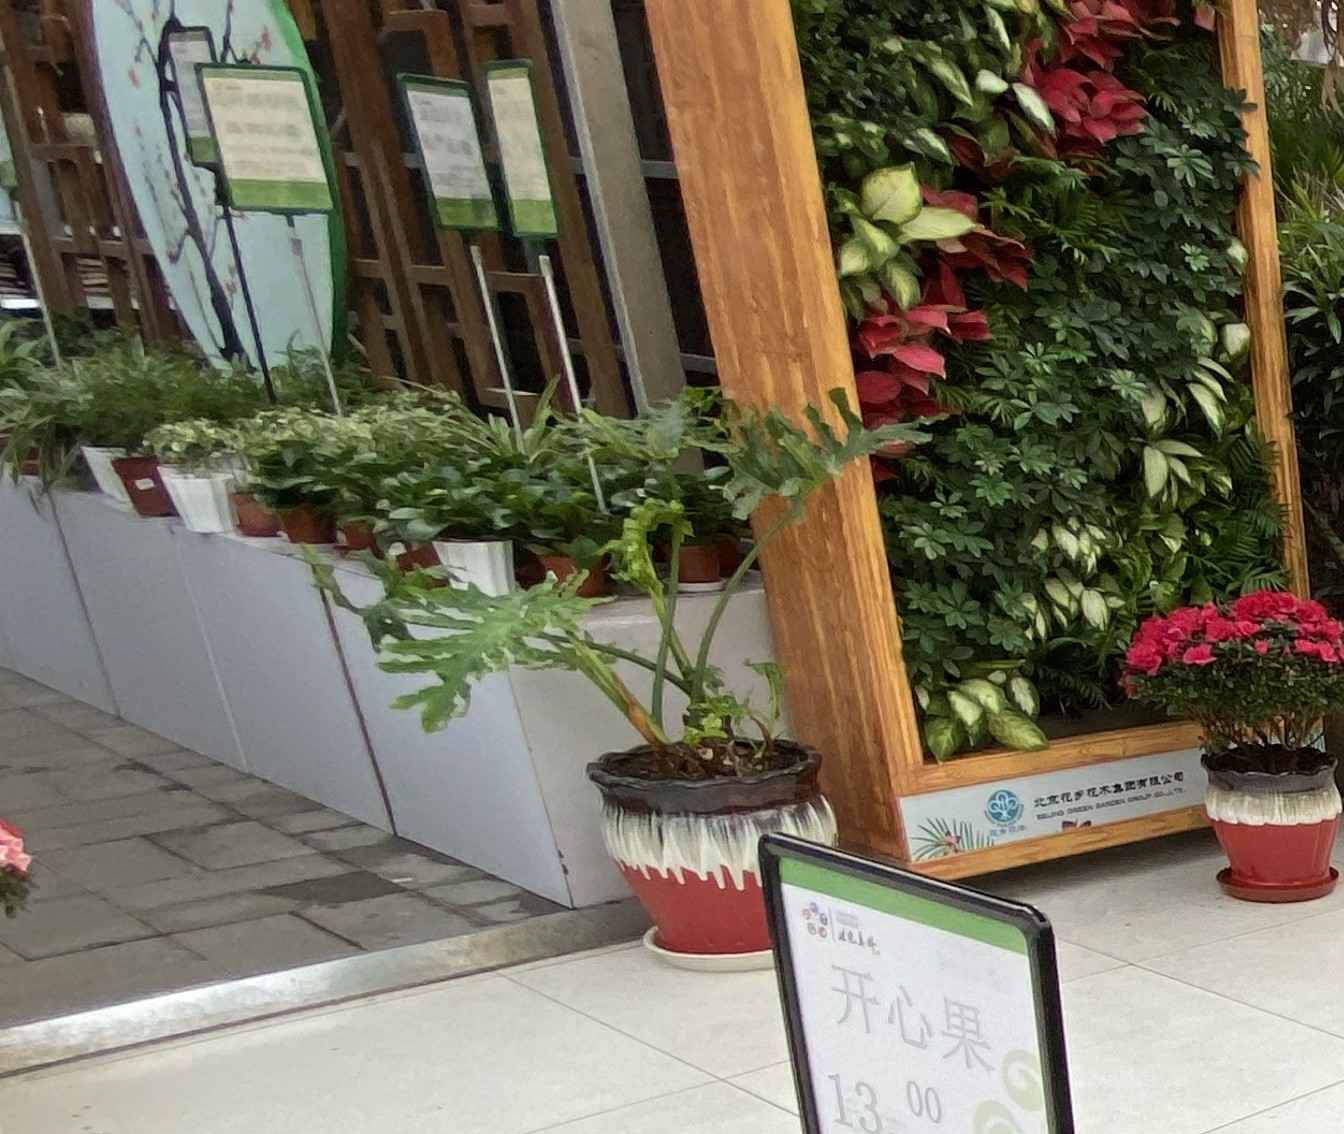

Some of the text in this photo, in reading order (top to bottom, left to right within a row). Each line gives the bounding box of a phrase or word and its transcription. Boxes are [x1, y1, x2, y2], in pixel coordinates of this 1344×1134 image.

[830, 963, 995, 1074] 开心果
[905, 1079, 943, 1125] 00
